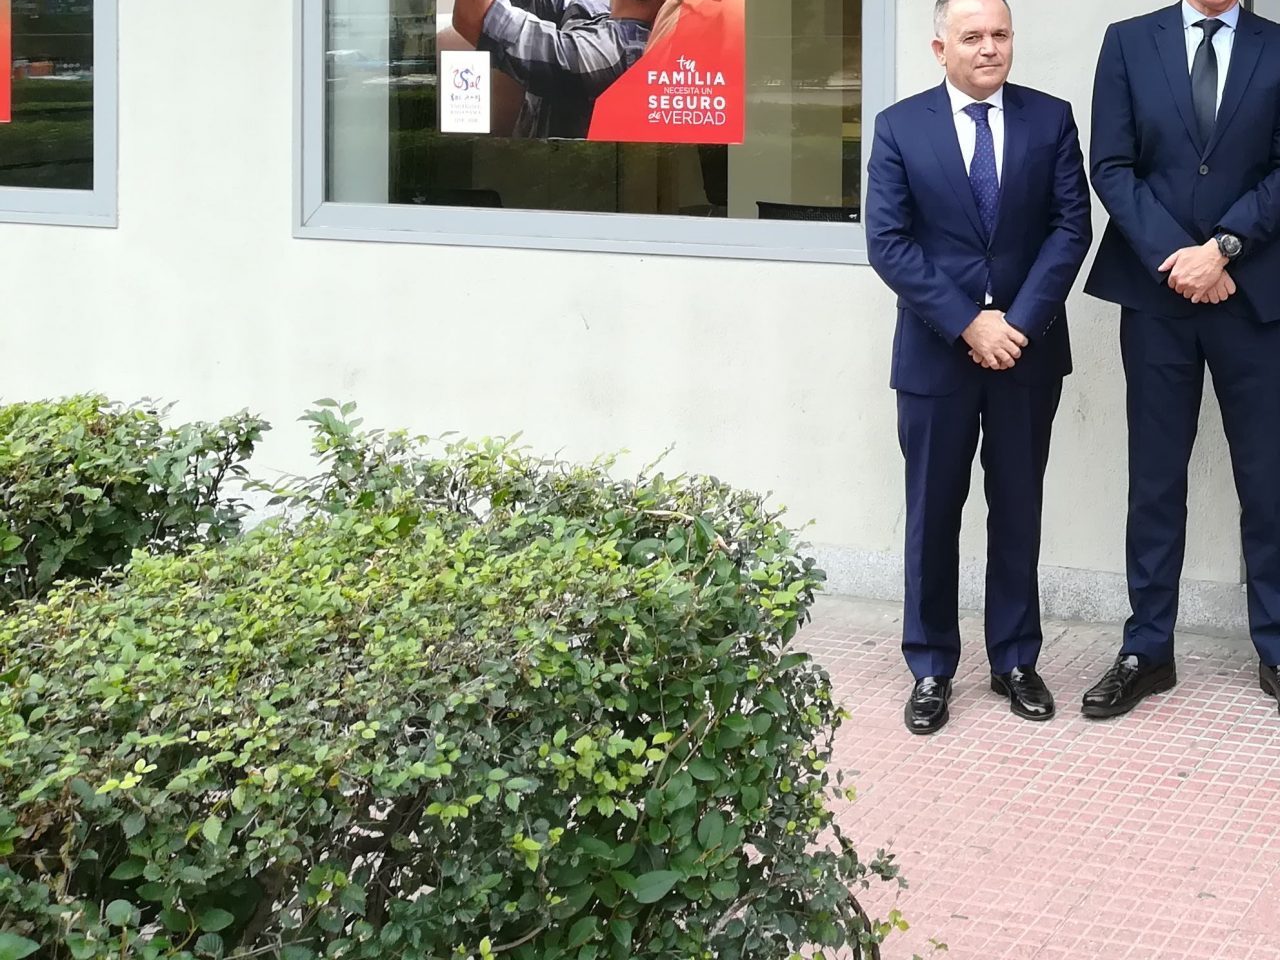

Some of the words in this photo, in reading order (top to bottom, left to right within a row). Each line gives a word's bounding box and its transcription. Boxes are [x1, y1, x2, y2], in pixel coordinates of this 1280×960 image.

[647, 71, 726, 86] FAMILIA
[663, 87, 700, 95] NECESITA
[701, 87, 713, 95] UN
[648, 95, 726, 110] SEGURO
[661, 110, 726, 126] VERDAD
